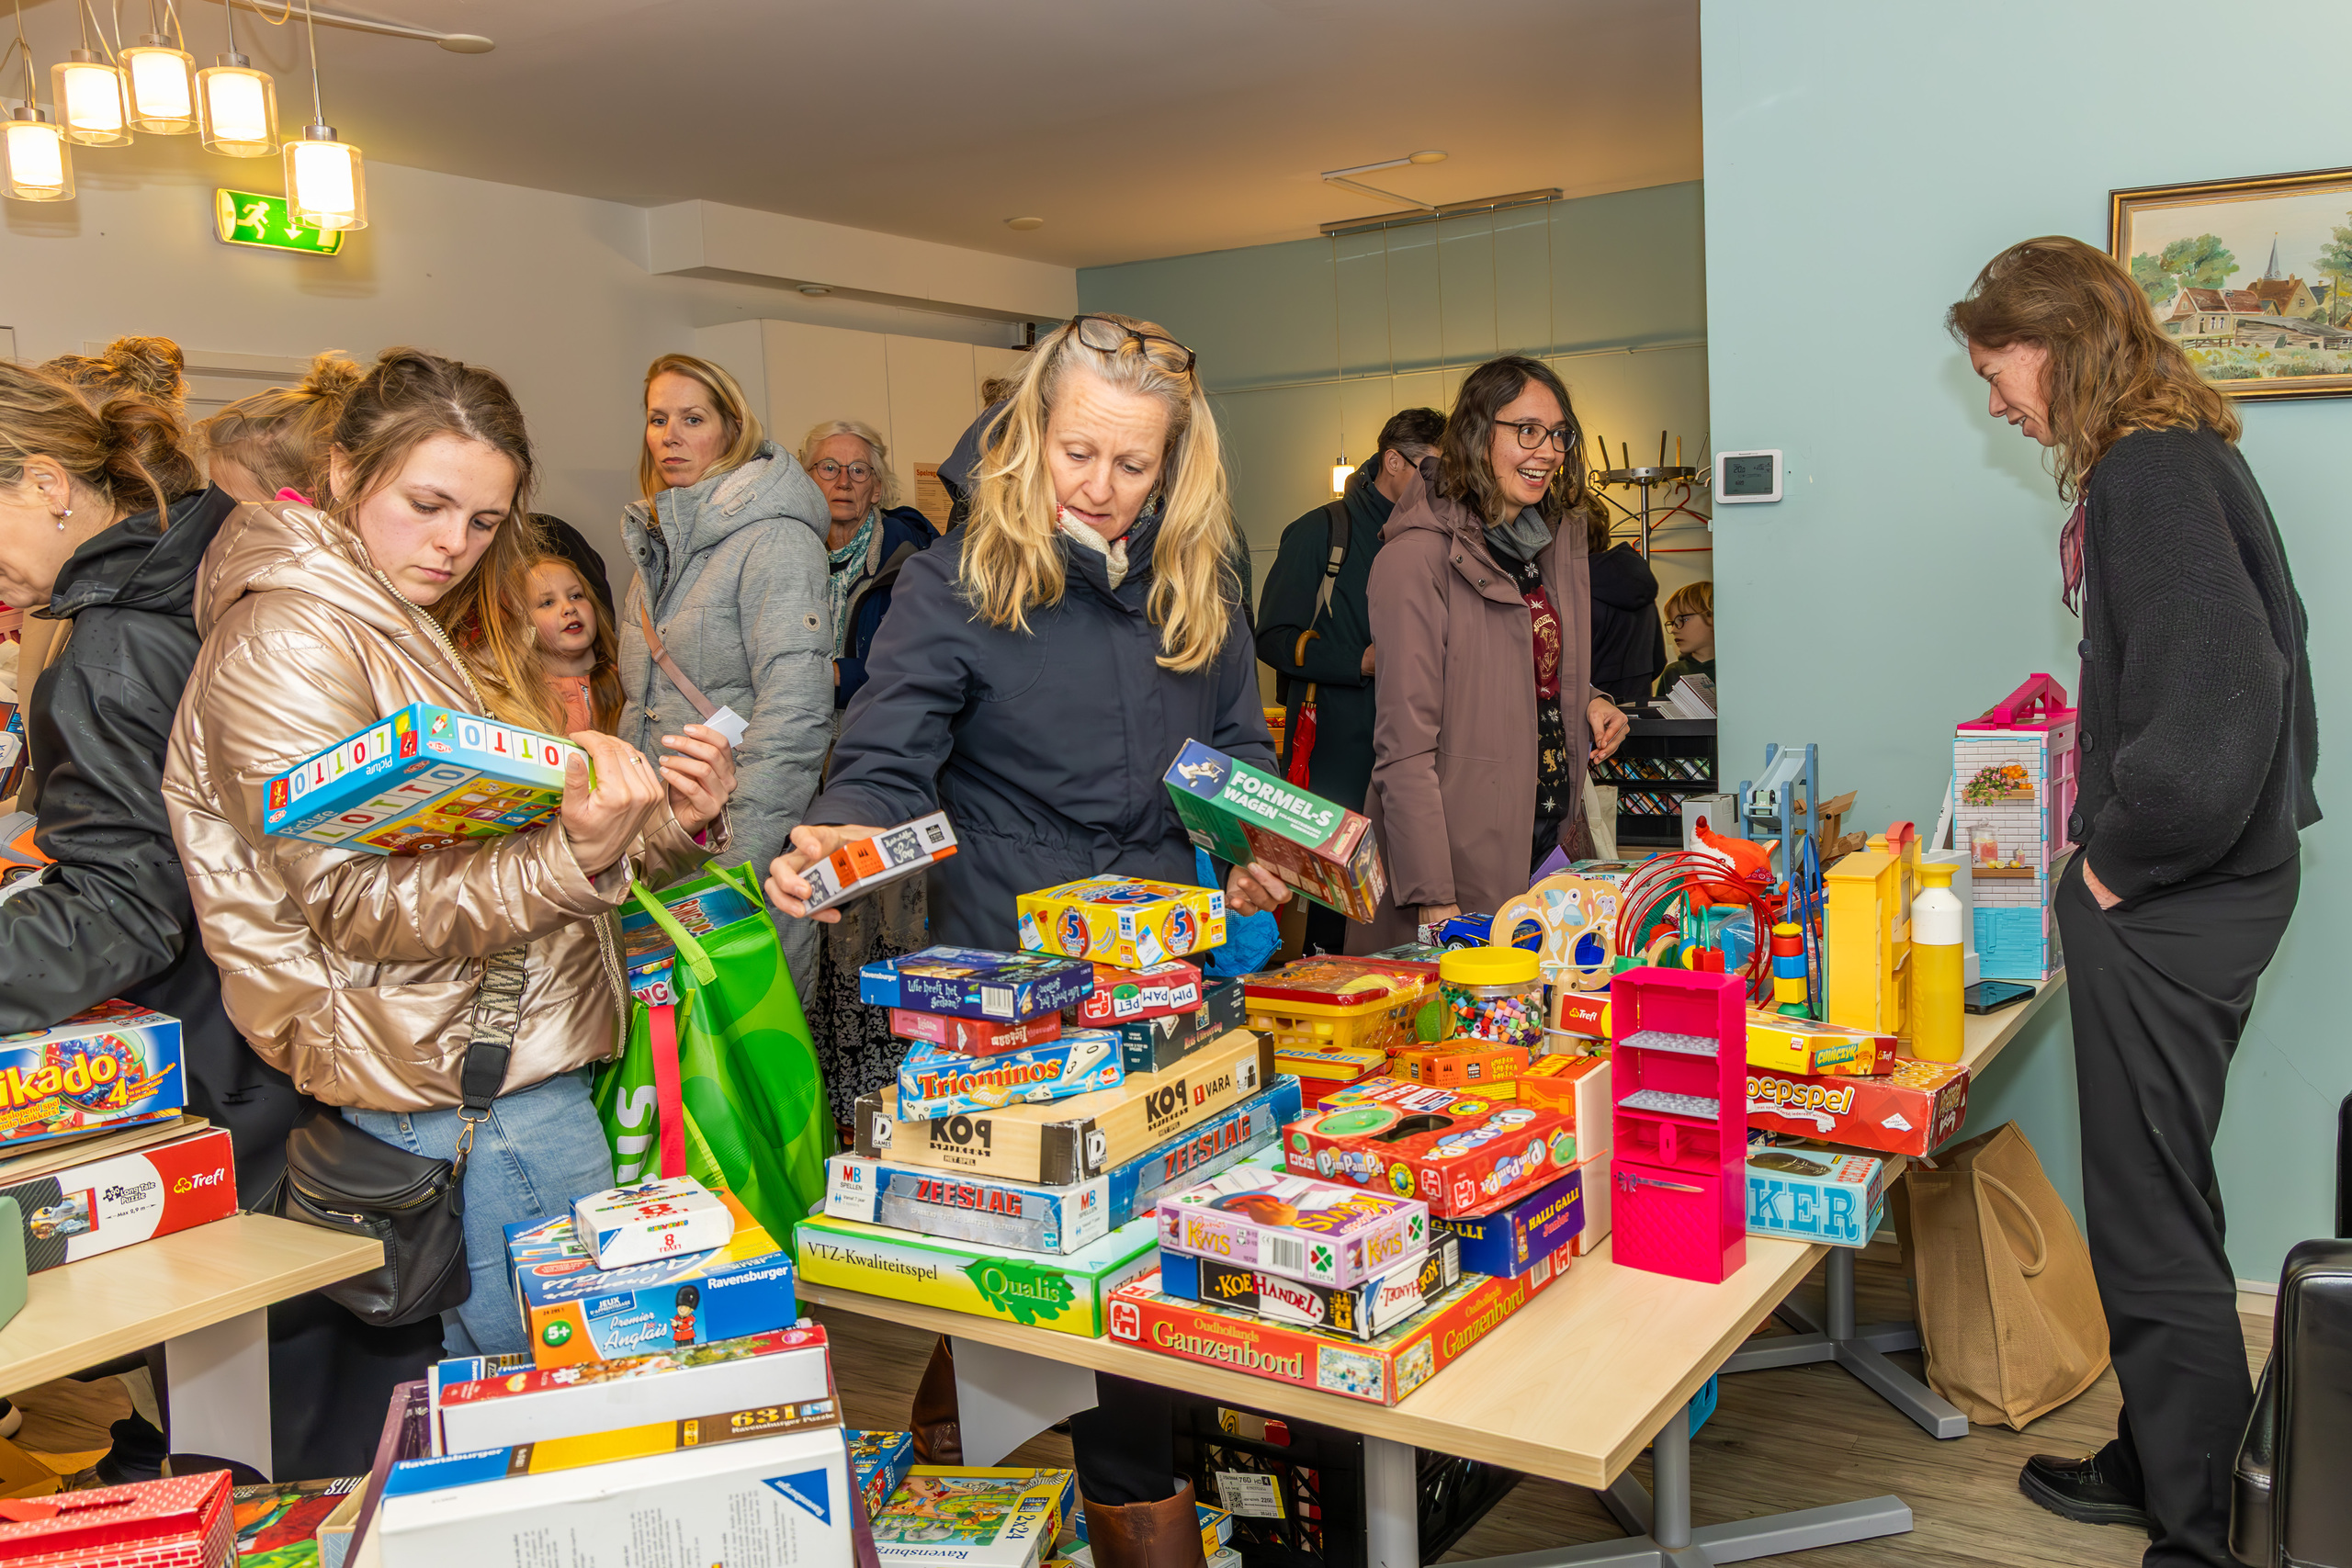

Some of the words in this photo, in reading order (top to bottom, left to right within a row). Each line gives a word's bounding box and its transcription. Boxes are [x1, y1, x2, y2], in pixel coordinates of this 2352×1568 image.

[294, 731, 385, 795] LOTTO
[366, 755, 393, 776] Picture
[311, 768, 466, 839] LOTTO
[1223, 786, 1279, 820] WAGEN
[1230, 770, 1333, 828] FORMEL-S
[277, 809, 339, 835] Picture
[1066, 914, 1080, 940] 5
[1173, 910, 1187, 938] 5
[861, 970, 898, 982] Ravensburger
[1118, 998, 1140, 1012] PET
[1143, 990, 1168, 1002] PAM
[1172, 987, 1193, 1003] PIM
[1577, 1009, 1598, 1021] Trefl
[990, 1024, 1028, 1047] Lichaam
[1275, 1048, 1364, 1064] POPQUIZ
[917, 1058, 1062, 1101] Triominos
[1205, 1074, 1231, 1097] VARA
[108, 1077, 129, 1107] 4
[42, 1098, 61, 1111] spel
[875, 1117, 892, 1141] D
[1164, 1114, 1251, 1181] ZEESLAG
[843, 1165, 862, 1183] MB
[1319, 1151, 1385, 1176] PimPamPet
[120, 1187, 140, 1197] Long
[140, 1181, 156, 1191] Tale
[192, 1168, 225, 1189] Trefl
[840, 1181, 863, 1191] SPELLEN
[120, 1192, 146, 1205] Puzzle
[916, 1179, 1023, 1217] ZEESLAG
[1080, 1190, 1097, 1211] MB
[1529, 1203, 1555, 1231] HALLI
[1555, 1187, 1580, 1213] GALLI
[1746, 1178, 1860, 1241] KER
[1543, 1212, 1569, 1237] Junior
[664, 1234, 674, 1247] 8
[1187, 1220, 1231, 1256] KWIS
[1367, 1232, 1402, 1268] KWIS
[808, 1241, 938, 1282] VTZ-Kwaliteitsspel
[707, 1264, 789, 1291] Ravensburger
[981, 1266, 1060, 1305] Qualis
[1309, 1269, 1335, 1282] SELECTA
[598, 1296, 620, 1309] JEUX
[548, 1325, 571, 1339] 5+
[610, 1312, 656, 1330] Premier
[1193, 1317, 1260, 1343] Oudhollands
[1442, 1280, 1526, 1360] Ganzenbord
[604, 1322, 668, 1351] Anglais
[1152, 1320, 1304, 1380] Ganzenbord
[730, 1404, 797, 1427] 631
[731, 1417, 800, 1434] Ravensburger
[803, 1413, 835, 1424] Puzzle
[399, 1448, 504, 1471] Ravensburger
[1005, 1514, 1037, 1540] 2x24
